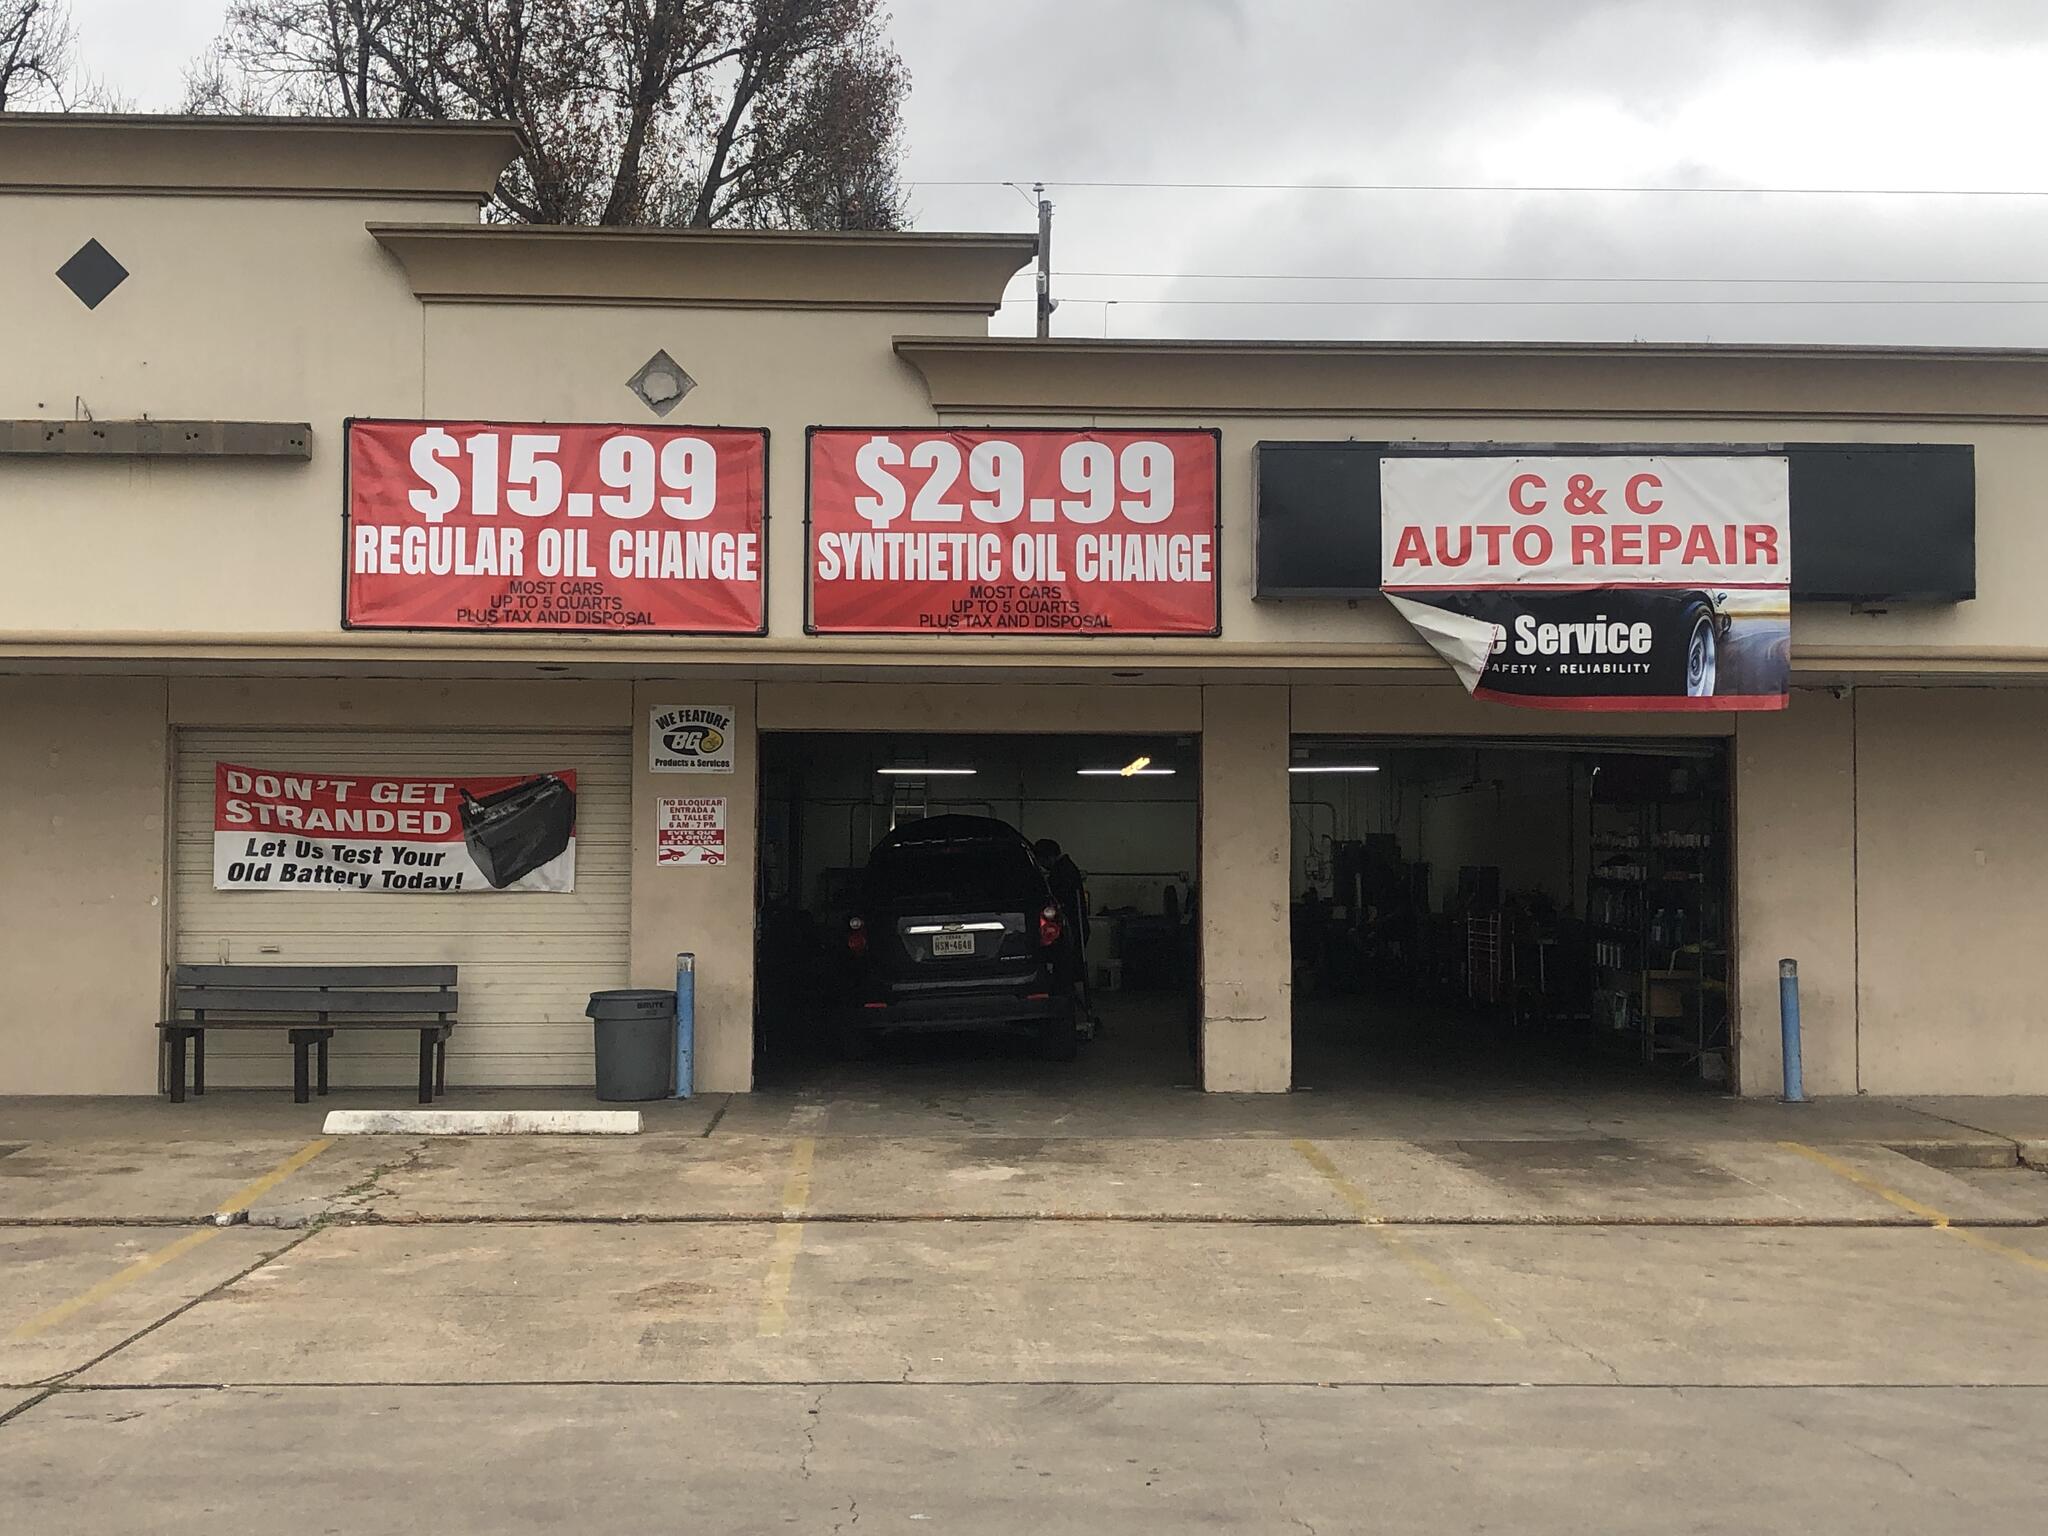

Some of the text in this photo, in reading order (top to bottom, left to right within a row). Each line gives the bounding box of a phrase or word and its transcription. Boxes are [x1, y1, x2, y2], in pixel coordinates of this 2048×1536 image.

[408, 427, 717, 523] $15.99
[854, 436, 1175, 529] $29.99
[1508, 473, 1664, 515] C & C
[354, 525, 757, 581] REGULAR OIL CHANGE
[817, 532, 1211, 583] SYNTHETIC OIL CHANGE
[1392, 524, 1779, 567] AUTO REPAIR
[490, 595, 622, 610] UP TO 5 QUARTS
[509, 581, 604, 596] MOST CARS
[970, 586, 1061, 599] MOST CARS
[457, 608, 655, 625] PLUS TAX AND DISPOSAL
[919, 614, 1112, 628] PLUS TAX AND DISPOSAL
[951, 600, 1080, 614] UP TO 5 QUARTS
[1515, 615, 1652, 655] Service
[1559, 663, 1651, 675] RELIABILITY
[655, 709, 730, 731] WE FEATURE
[655, 758, 689, 767] Products
[697, 759, 730, 768] Services
[227, 770, 455, 804] DON'T GET
[225, 799, 451, 834] STRANDED
[678, 799, 723, 807] BLOQUEAR
[245, 838, 446, 867] Let Us Test Your
[227, 862, 464, 891] Old Battery Today!
